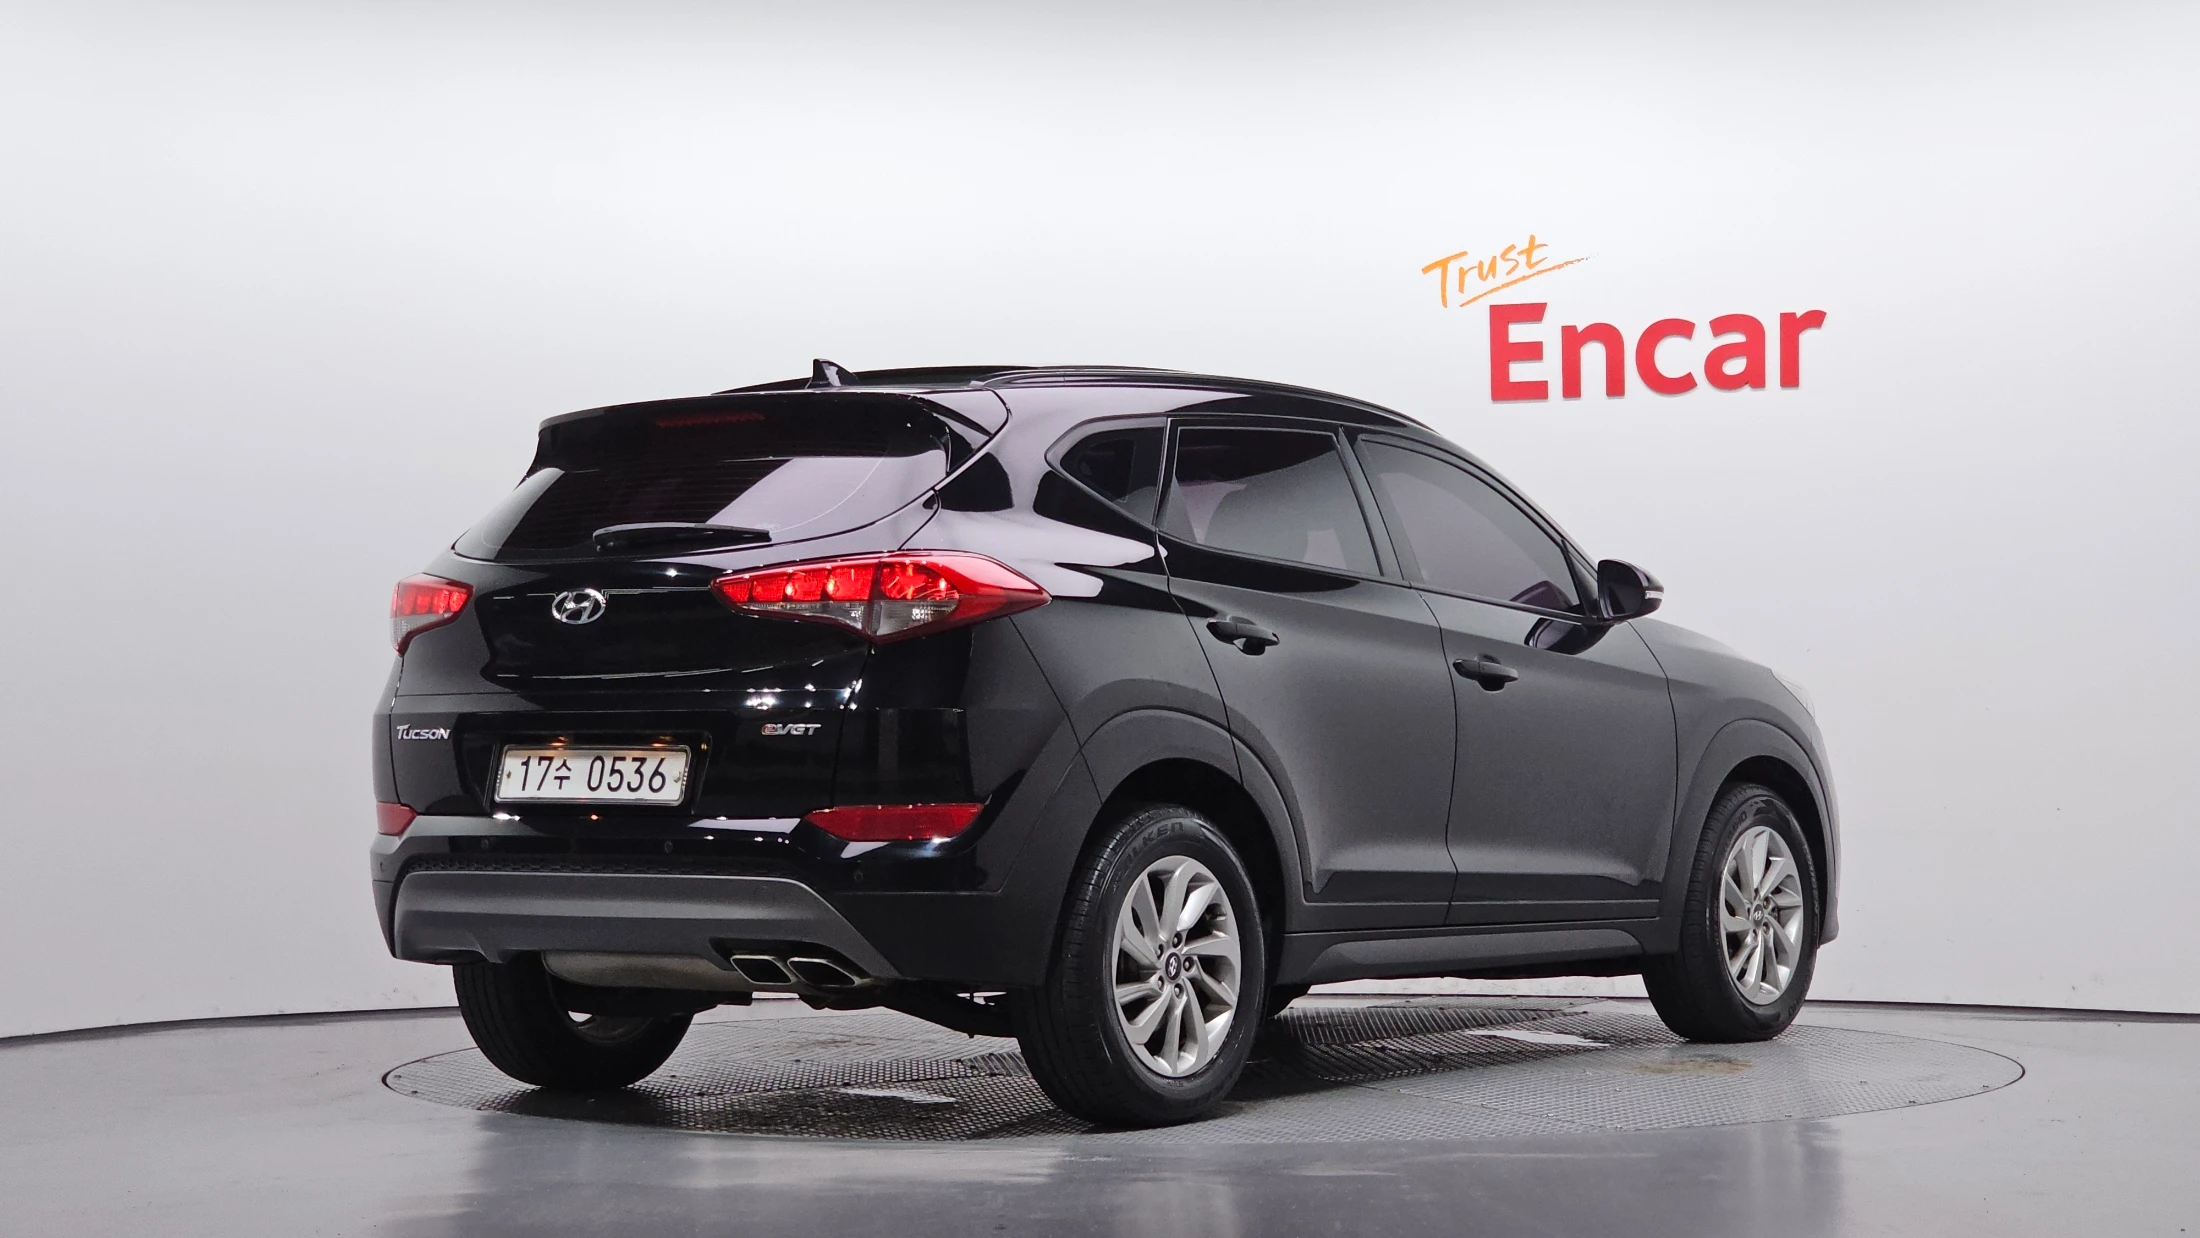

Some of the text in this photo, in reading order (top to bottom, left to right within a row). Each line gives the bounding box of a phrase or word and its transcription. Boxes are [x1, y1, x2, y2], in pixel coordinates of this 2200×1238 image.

[1421, 234, 1549, 308] Trust
[1489, 301, 1828, 402] Encar
[396, 723, 451, 740] TUCSON
[520, 755, 667, 793] 17수 0536
[1117, 821, 1184, 870] ALKEN
